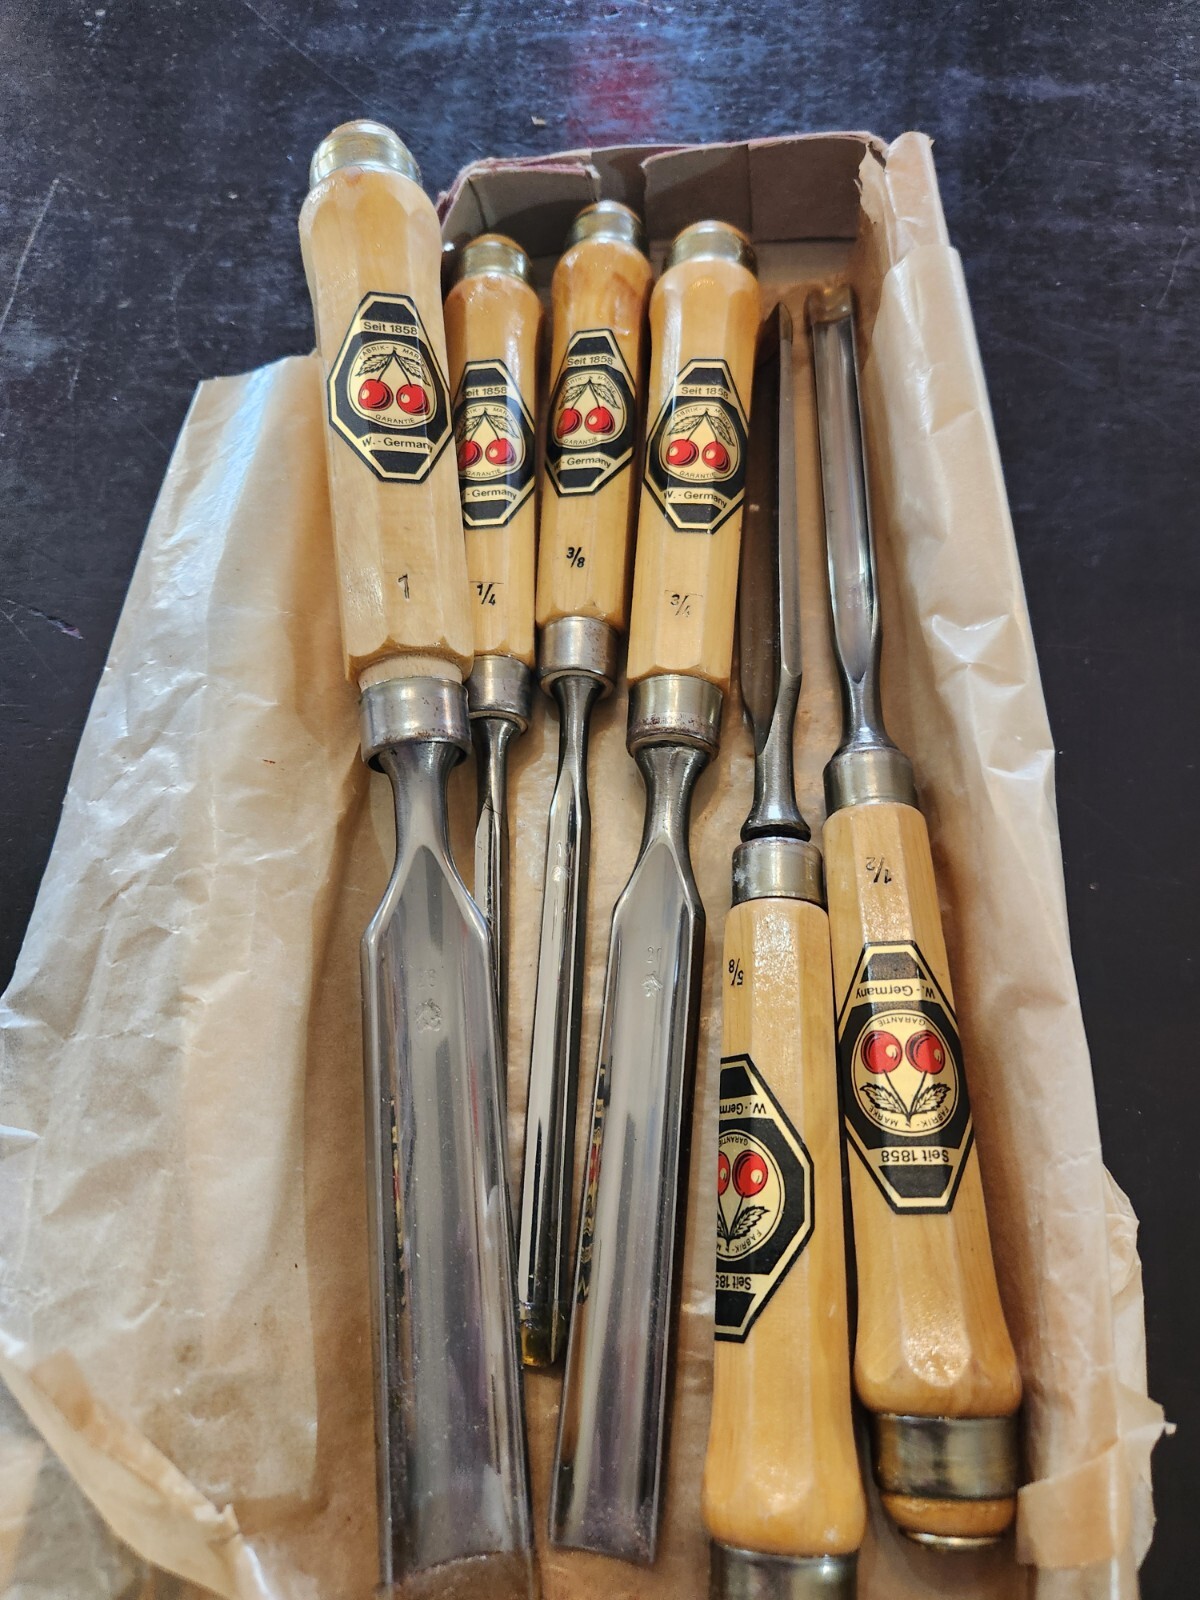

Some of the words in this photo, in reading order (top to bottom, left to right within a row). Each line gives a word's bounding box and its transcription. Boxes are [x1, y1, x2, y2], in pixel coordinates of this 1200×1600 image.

[363, 322, 386, 332] Seit
[390, 324, 418, 335] 1858
[567, 358, 587, 366] Seit
[590, 356, 613, 365] 1858
[482, 386, 508, 396] 1858
[681, 387, 702, 395] Seit
[706, 387, 729, 400] 1858
[375, 414, 415, 425] GARANTIE
[566, 546, 585, 568] 3/8
[476, 583, 496, 606] 1/4
[865, 856, 892, 884] 1/2
[728, 958, 745, 986] 5/8
[877, 1016, 926, 1027] GARANTIE
[869, 1105, 899, 1127] MARKE
[881, 1149, 919, 1162] 1858
[924, 1149, 950, 1162] Seit
[732, 1275, 752, 1290] Seit
